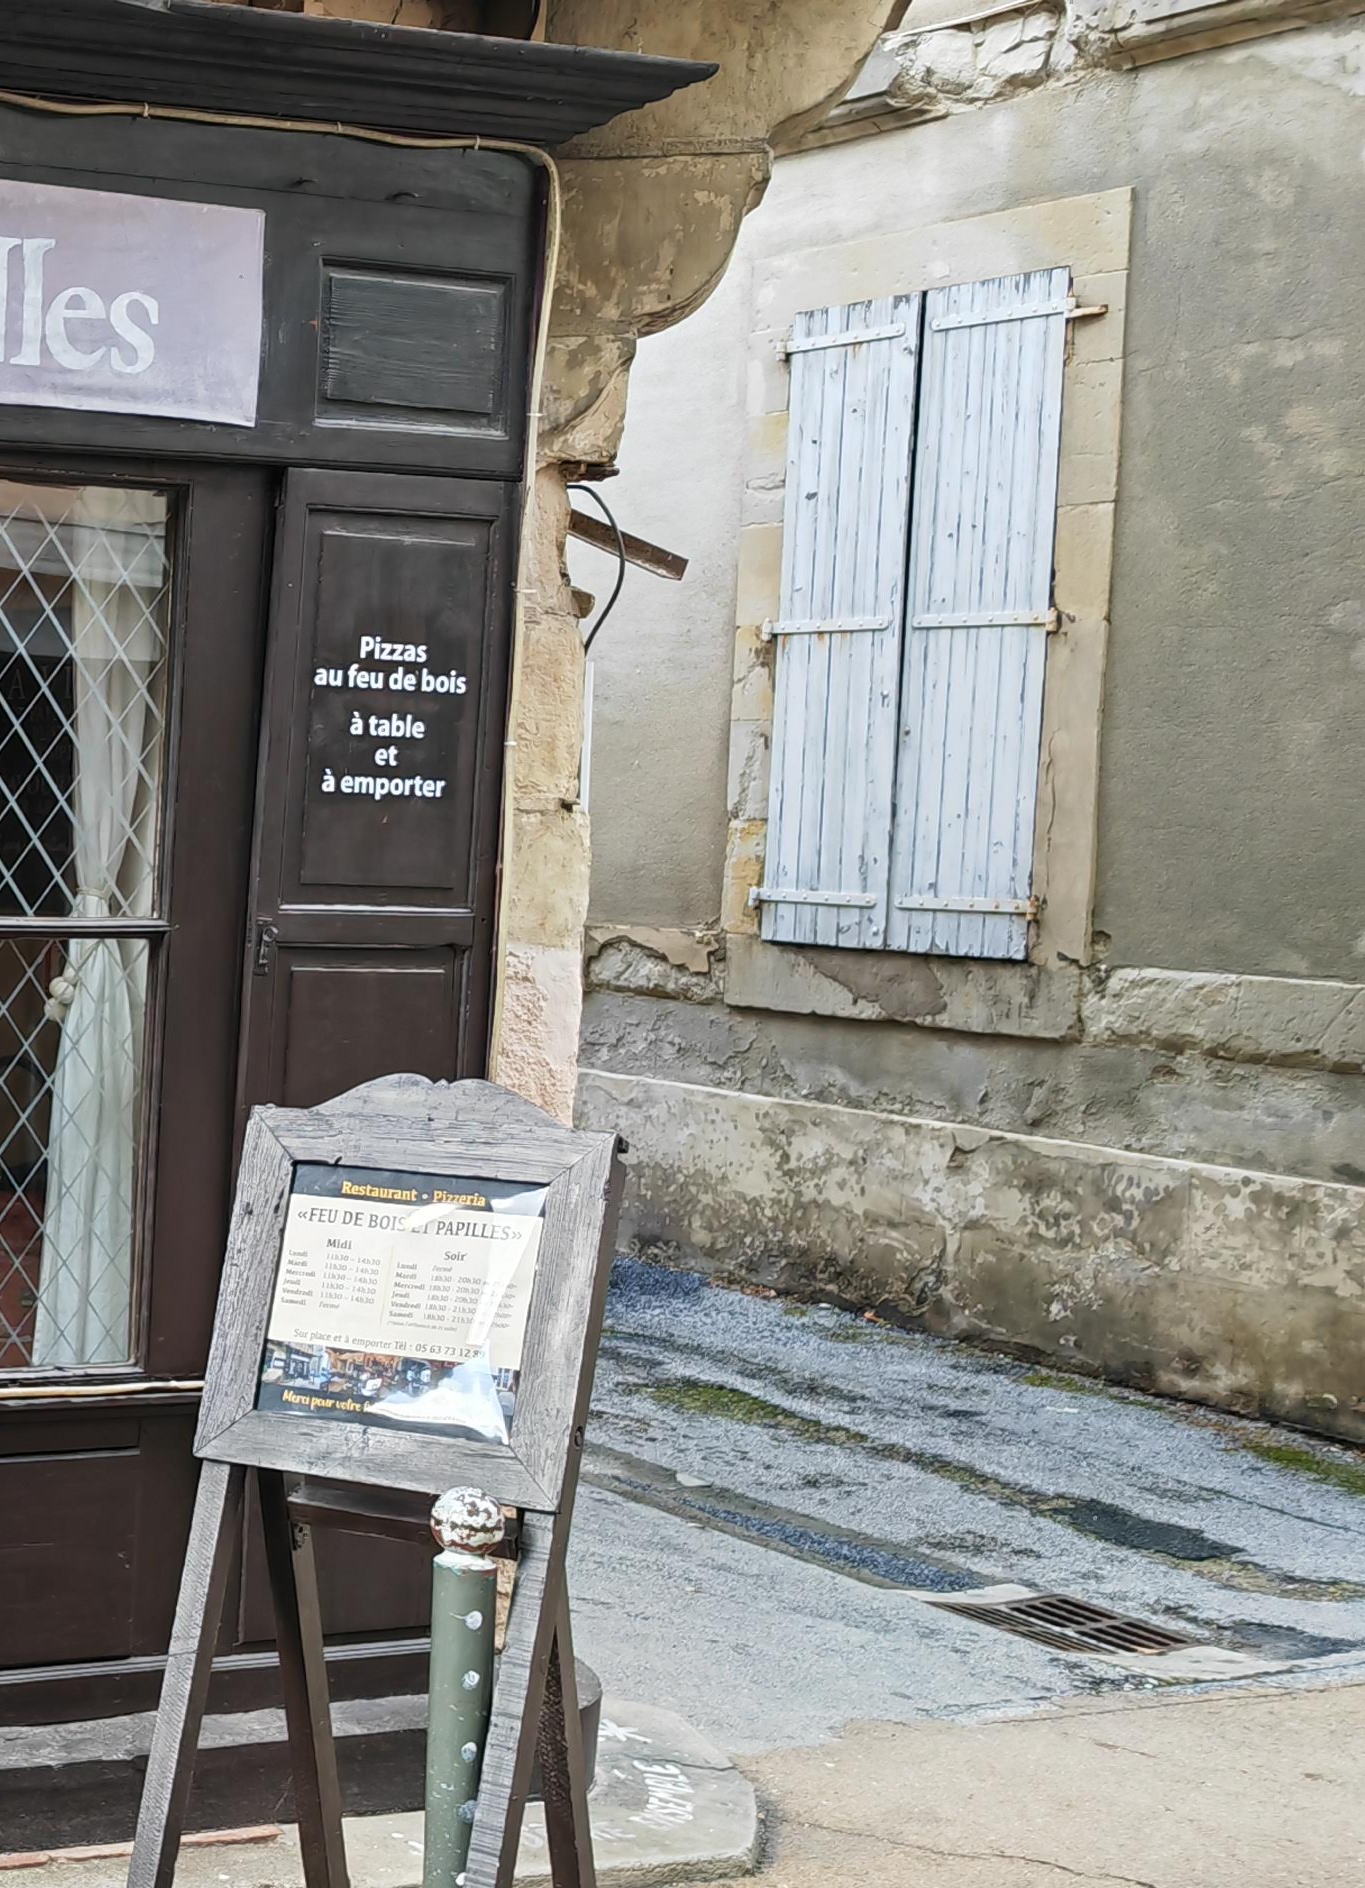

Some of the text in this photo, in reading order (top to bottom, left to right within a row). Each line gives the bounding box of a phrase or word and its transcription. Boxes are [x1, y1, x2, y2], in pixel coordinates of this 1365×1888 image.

[360, 636, 428, 663] Pizzas
[314, 664, 466, 694] au feu de bois
[350, 712, 425, 739] à table
[374, 746, 398, 767] et
[322, 768, 446, 801] à emporter
[341, 1180, 486, 1206] Restaurant Pizzeria
[342, 1211, 364, 1226] DE
[368, 1213, 406, 1232] BOIS
[325, 1237, 353, 1251] Midi
[443, 1250, 467, 1261] Soir
[294, 1328, 308, 1340] Sur
[310, 1331, 332, 1343] place
[333, 1334, 342, 1342] et
[344, 1335, 350, 1343] à
[352, 1338, 392, 1350] emporter
[415, 1343, 428, 1353] 05
[429, 1345, 442, 1354] 63
[444, 1347, 456, 1357] 73
[459, 1348, 470, 1358] 12
[282, 1389, 309, 1404] Merci
[310, 1396, 334, 1410] pour
[336, 1397, 361, 1412] votre
